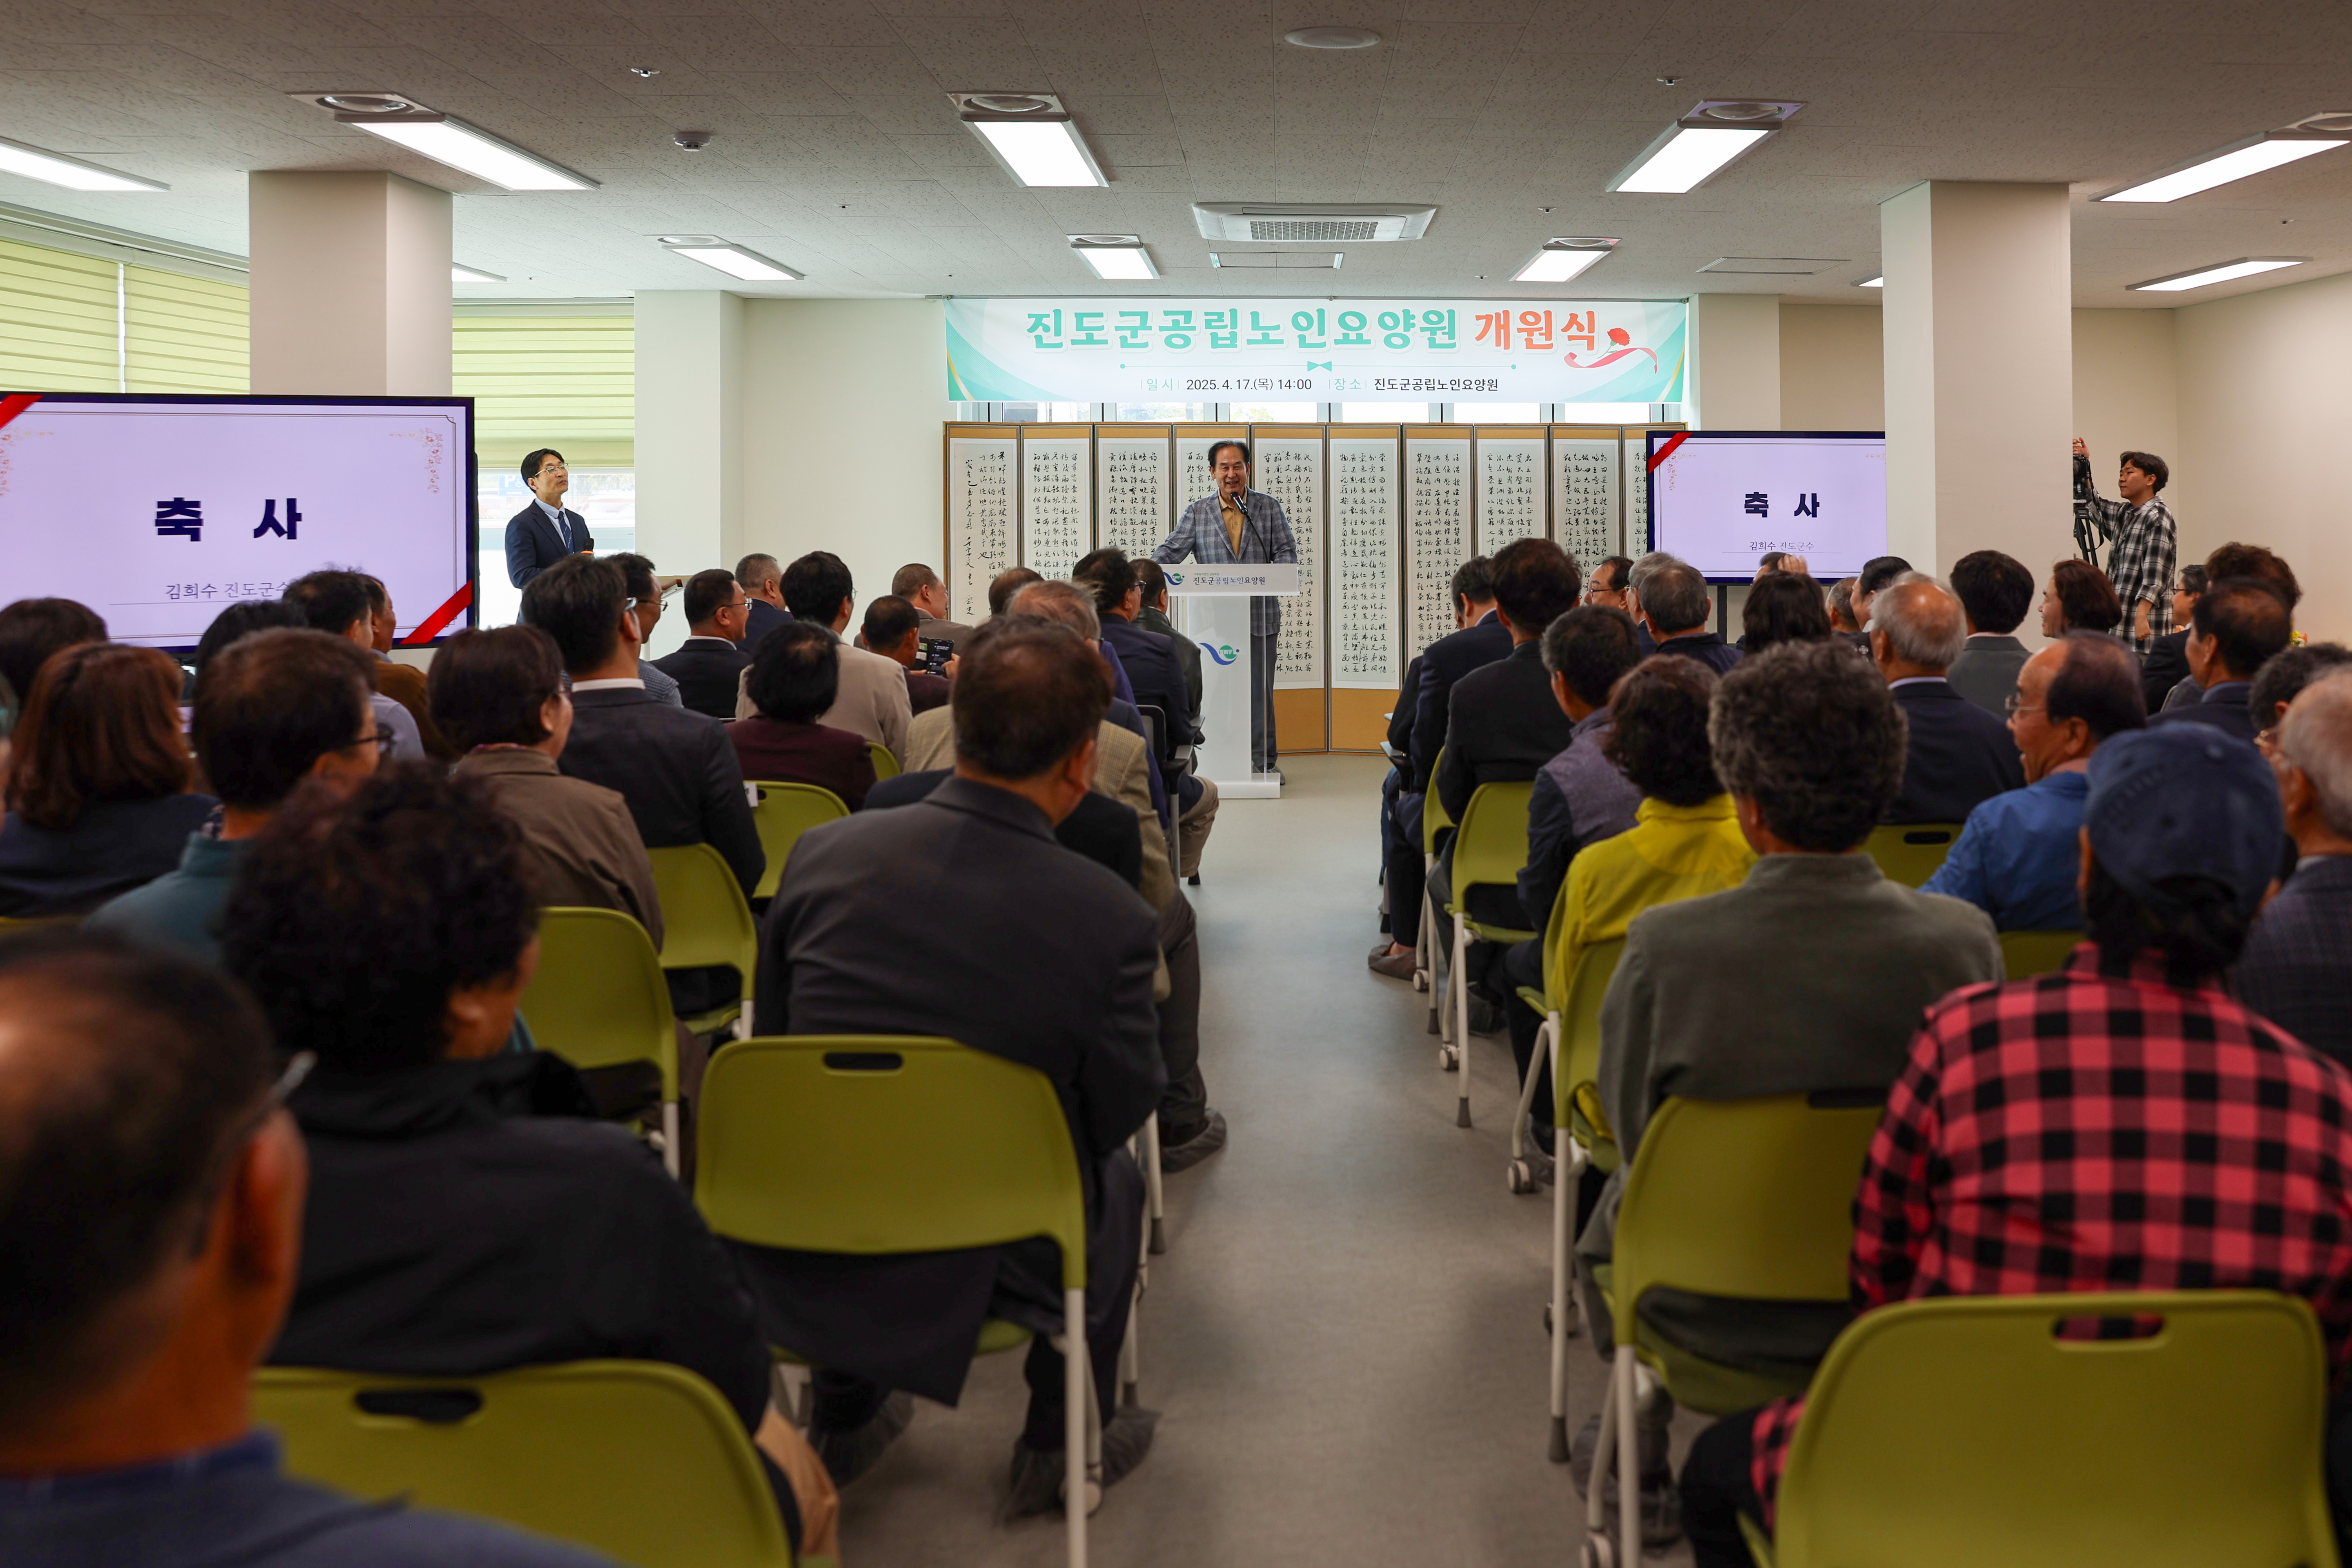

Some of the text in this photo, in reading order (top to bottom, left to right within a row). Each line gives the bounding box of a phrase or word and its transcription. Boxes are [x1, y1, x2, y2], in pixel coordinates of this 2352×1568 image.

[1026, 308, 1595, 350] 진도군공립노인요양원 개원식
[1278, 379, 1312, 390] 14:00
[1374, 378, 1498, 392] 진도군공립노인요양원
[1749, 541, 1814, 551] 김희수 진도군수
[1193, 577, 1265, 585] 진도군공립노인요양원
[166, 583, 218, 599] 김희수
